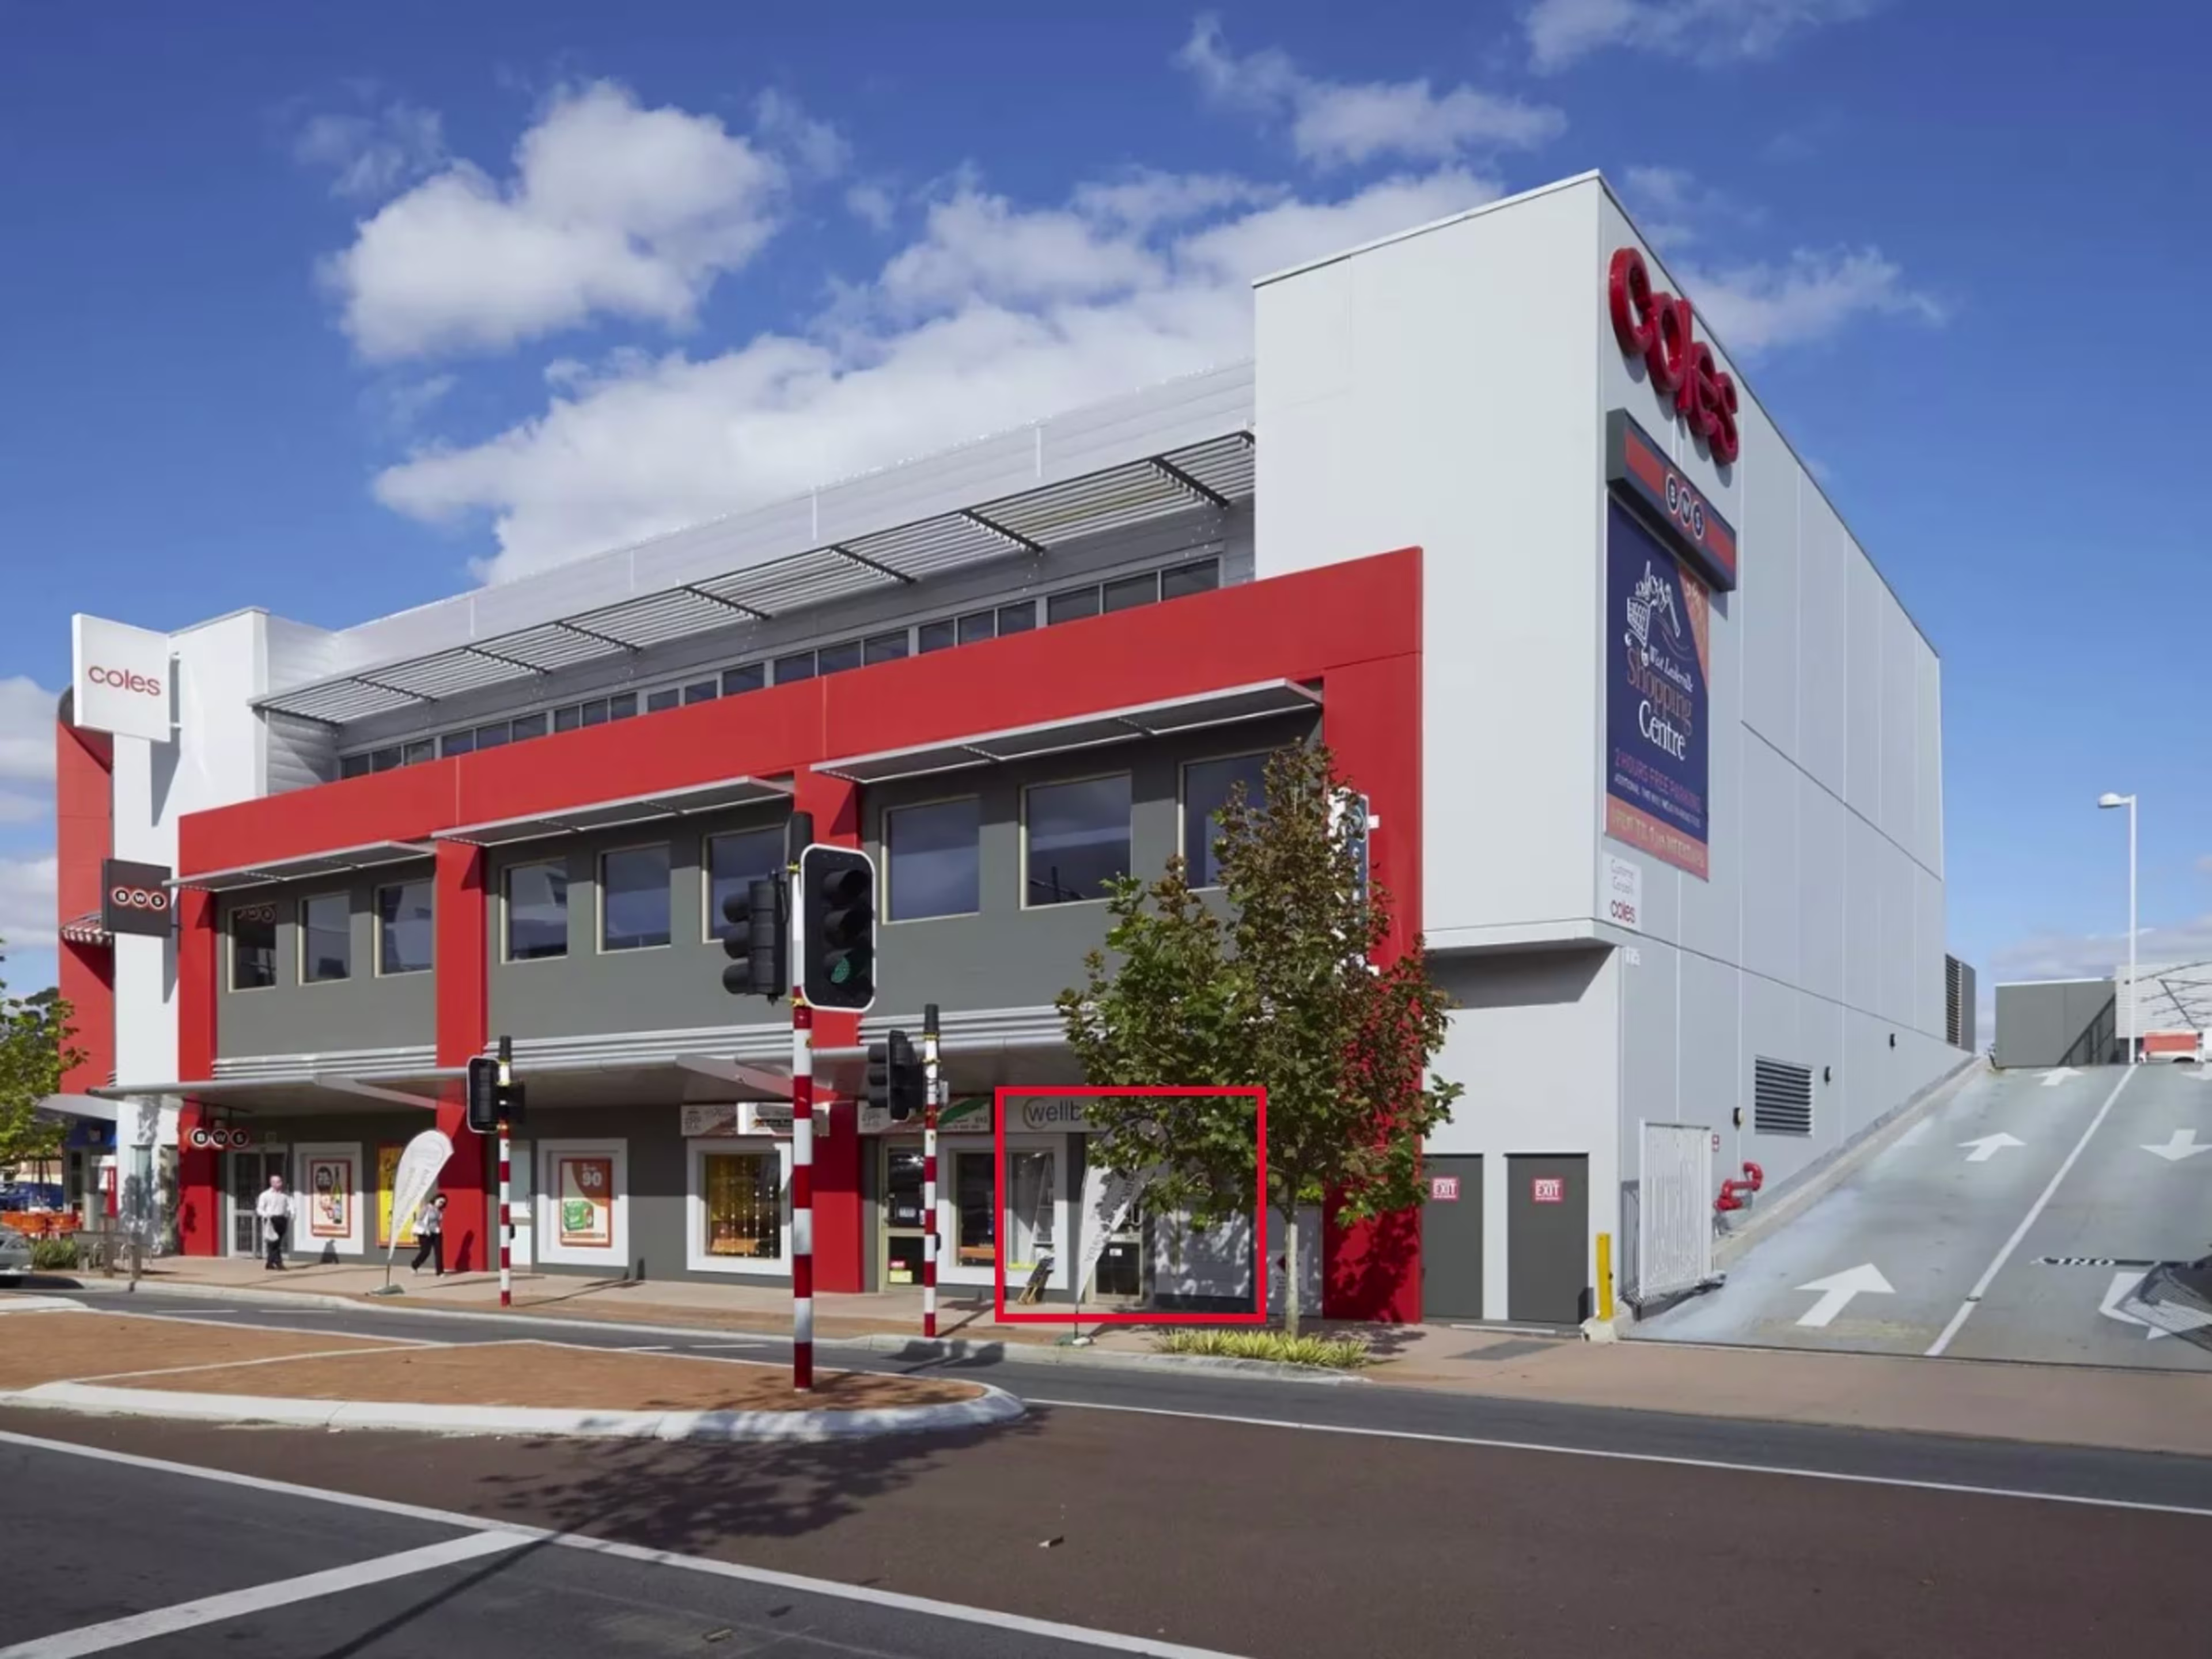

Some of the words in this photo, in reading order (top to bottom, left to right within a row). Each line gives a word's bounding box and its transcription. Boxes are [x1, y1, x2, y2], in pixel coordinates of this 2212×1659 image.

[1609, 247, 1738, 467] coles
[1668, 479, 1703, 536] BWS
[88, 666, 161, 696] coles
[1627, 646, 1692, 737] Shopping
[1639, 699, 1685, 761] Centre
[115, 888, 164, 908] BWS
[1610, 899, 1635, 923] coles
[194, 1131, 247, 1145] BWS
[582, 1171, 603, 1187] 90
[1433, 1183, 1457, 1196] EXIT
[1535, 1184, 1560, 1196] EXIT
